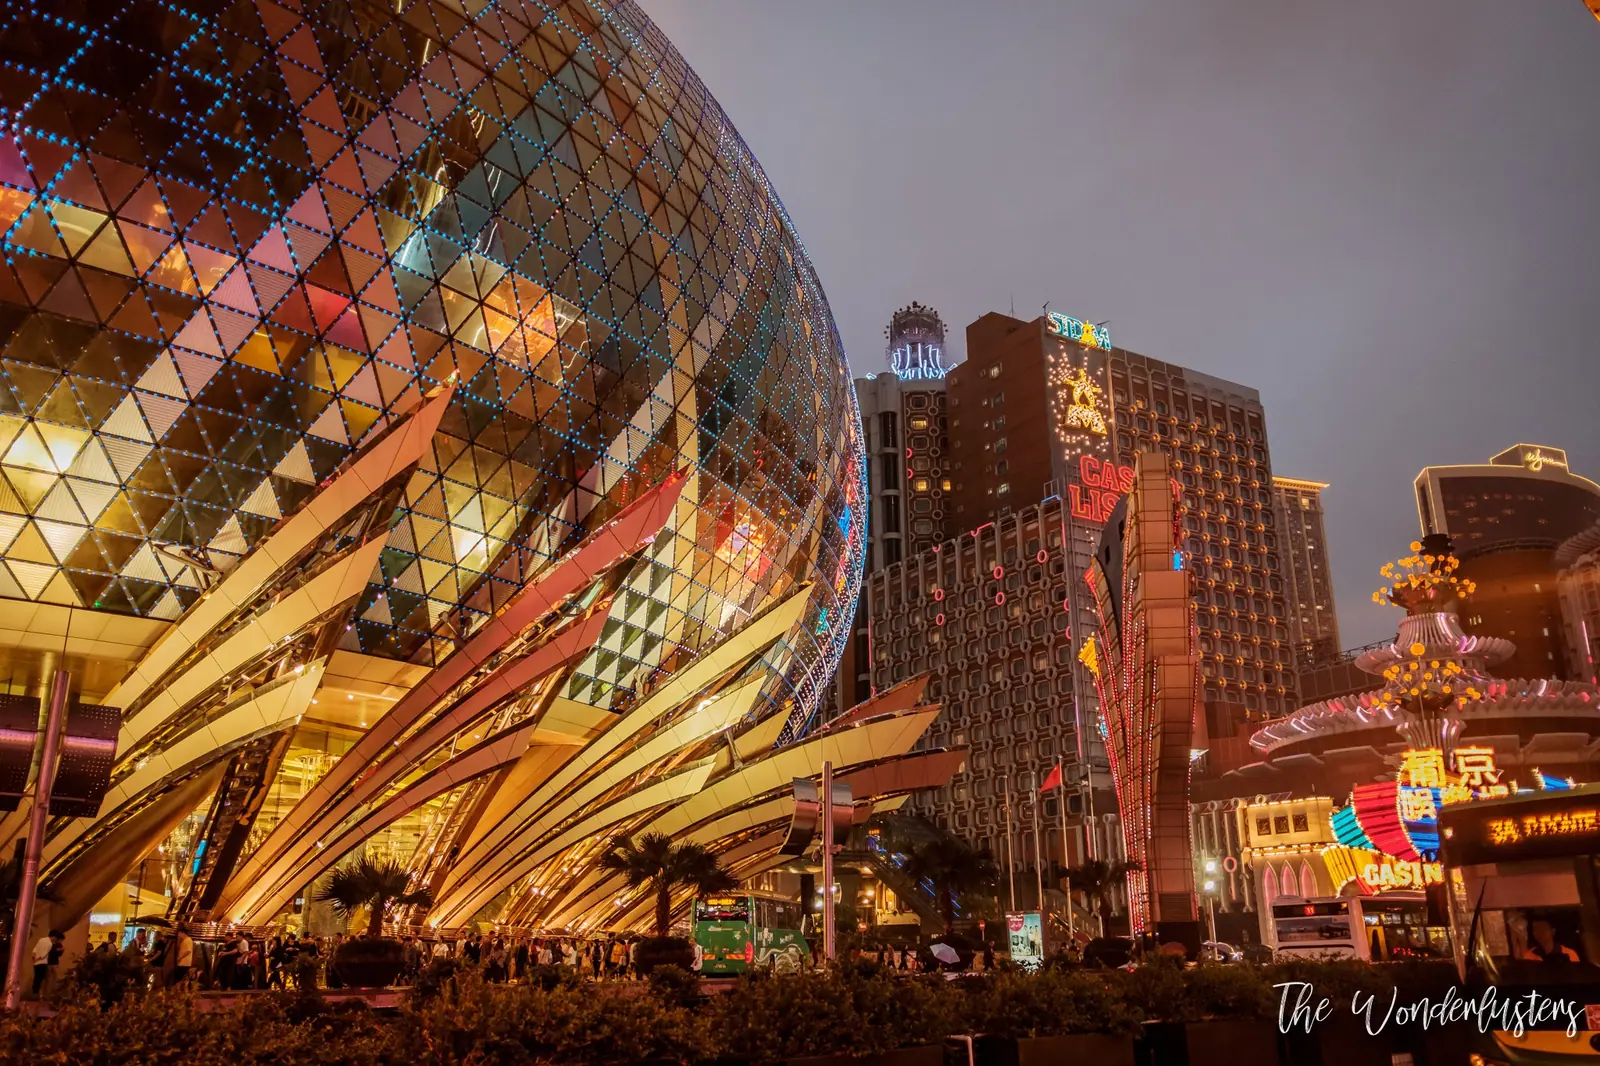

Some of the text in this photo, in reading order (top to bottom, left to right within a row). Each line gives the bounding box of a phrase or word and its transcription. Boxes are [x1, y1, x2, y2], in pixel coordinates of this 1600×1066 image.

[1080, 455, 1135, 493] CAS
[1069, 484, 1120, 522] LIS
[1364, 862, 1444, 886] CASIN
